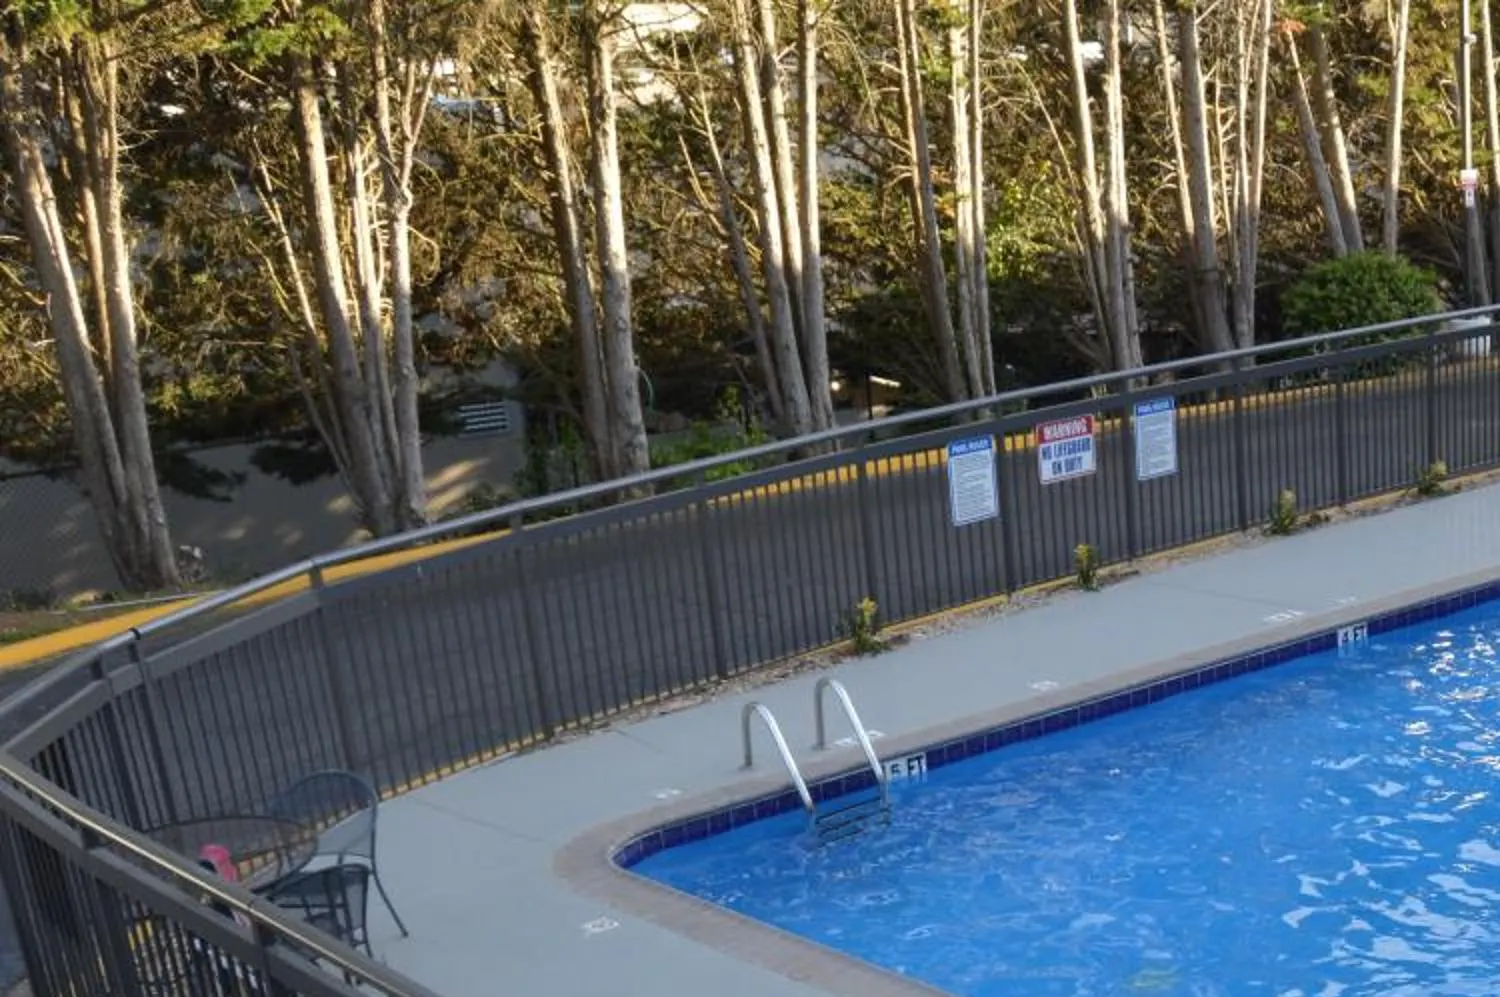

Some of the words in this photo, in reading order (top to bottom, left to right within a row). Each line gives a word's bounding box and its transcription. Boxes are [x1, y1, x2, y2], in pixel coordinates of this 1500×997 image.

[1043, 418, 1088, 442] WARNING
[1041, 445, 1053, 461] NO
[1051, 461, 1063, 476] ON
[1063, 456, 1083, 474] DUTY
